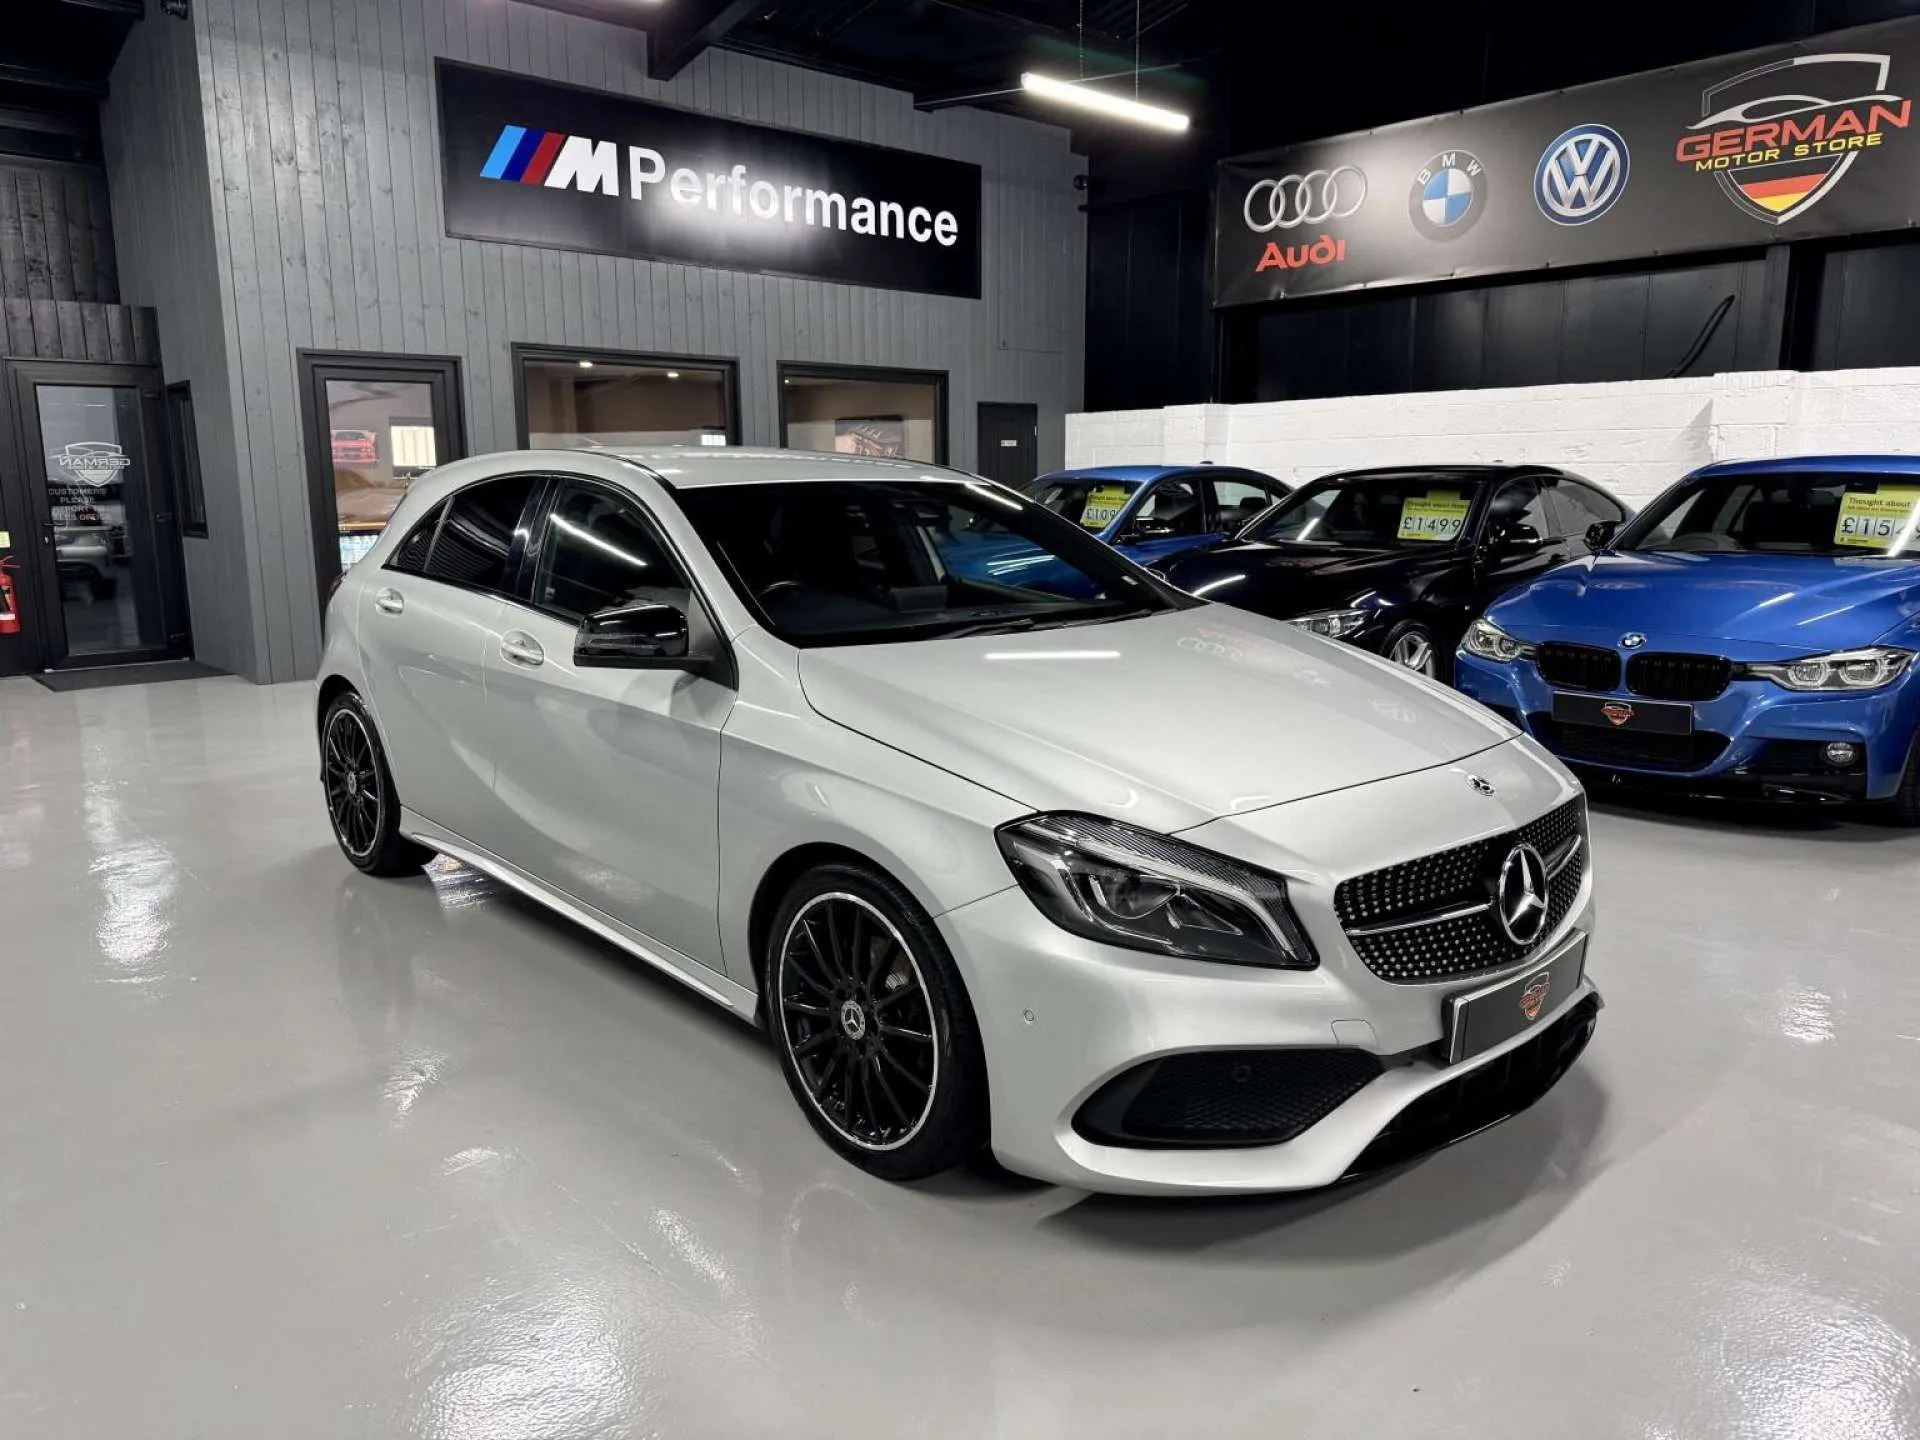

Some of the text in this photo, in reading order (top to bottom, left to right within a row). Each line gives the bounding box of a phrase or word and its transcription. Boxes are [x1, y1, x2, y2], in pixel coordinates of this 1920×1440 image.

[1675, 100, 1912, 162] GERMAN
[1416, 151, 1482, 186] BMW
[1695, 133, 1883, 172] MOTOR STORE
[543, 135, 959, 246] M Performance
[1255, 234, 1346, 272] Audi
[1087, 507, 1119, 520] £109
[1403, 516, 1461, 532] £1499
[1841, 517, 1905, 536] £15
